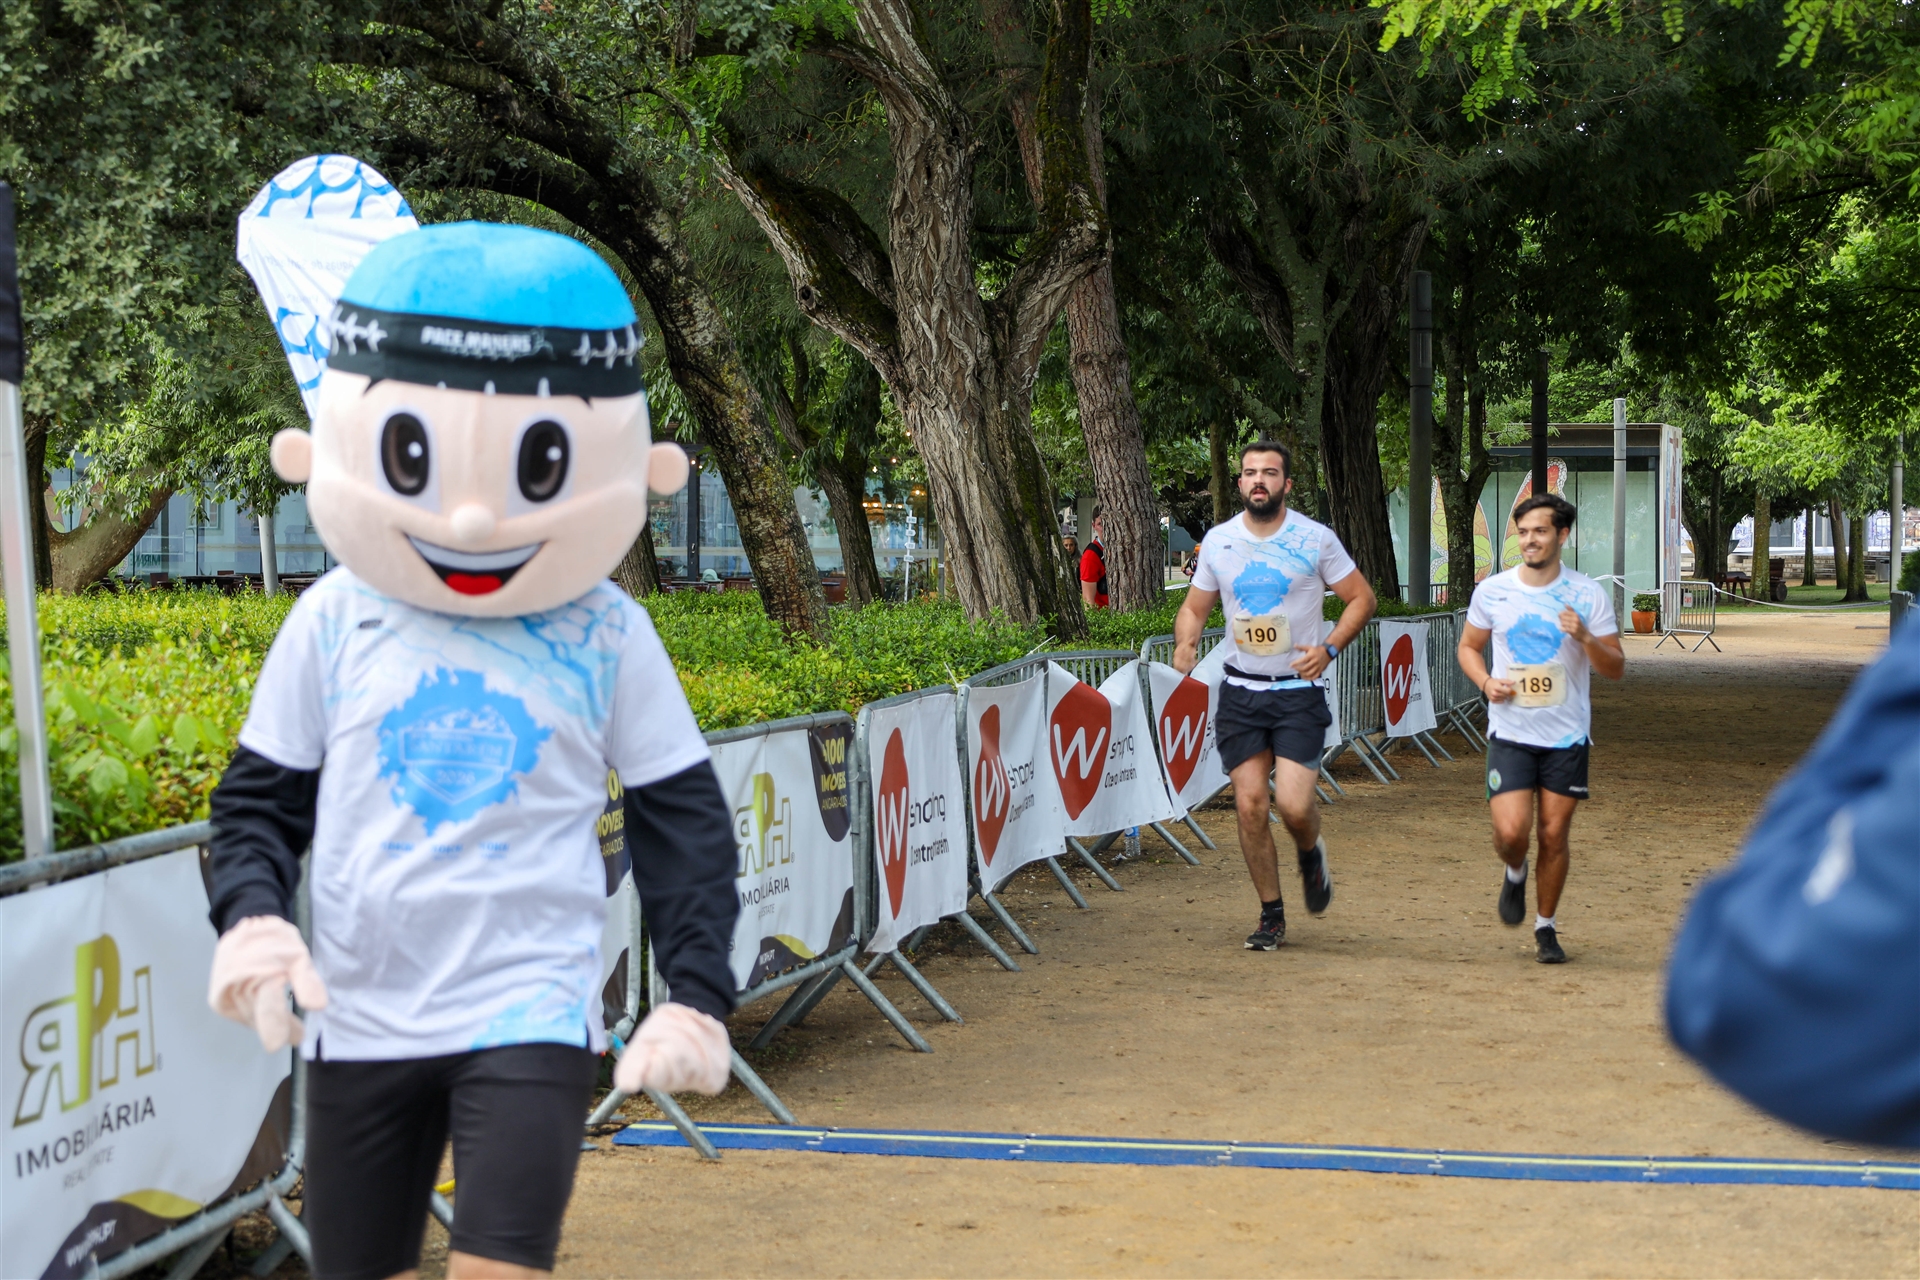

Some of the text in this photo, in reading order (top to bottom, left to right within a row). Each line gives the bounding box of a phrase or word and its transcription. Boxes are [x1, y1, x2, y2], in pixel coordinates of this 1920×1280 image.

[1245, 627, 1277, 643] 190
[1387, 663, 1412, 699] W
[1519, 676, 1553, 693] 189
[1053, 723, 1107, 780] W
[1164, 711, 1205, 764] W
[881, 786, 907, 867] W
